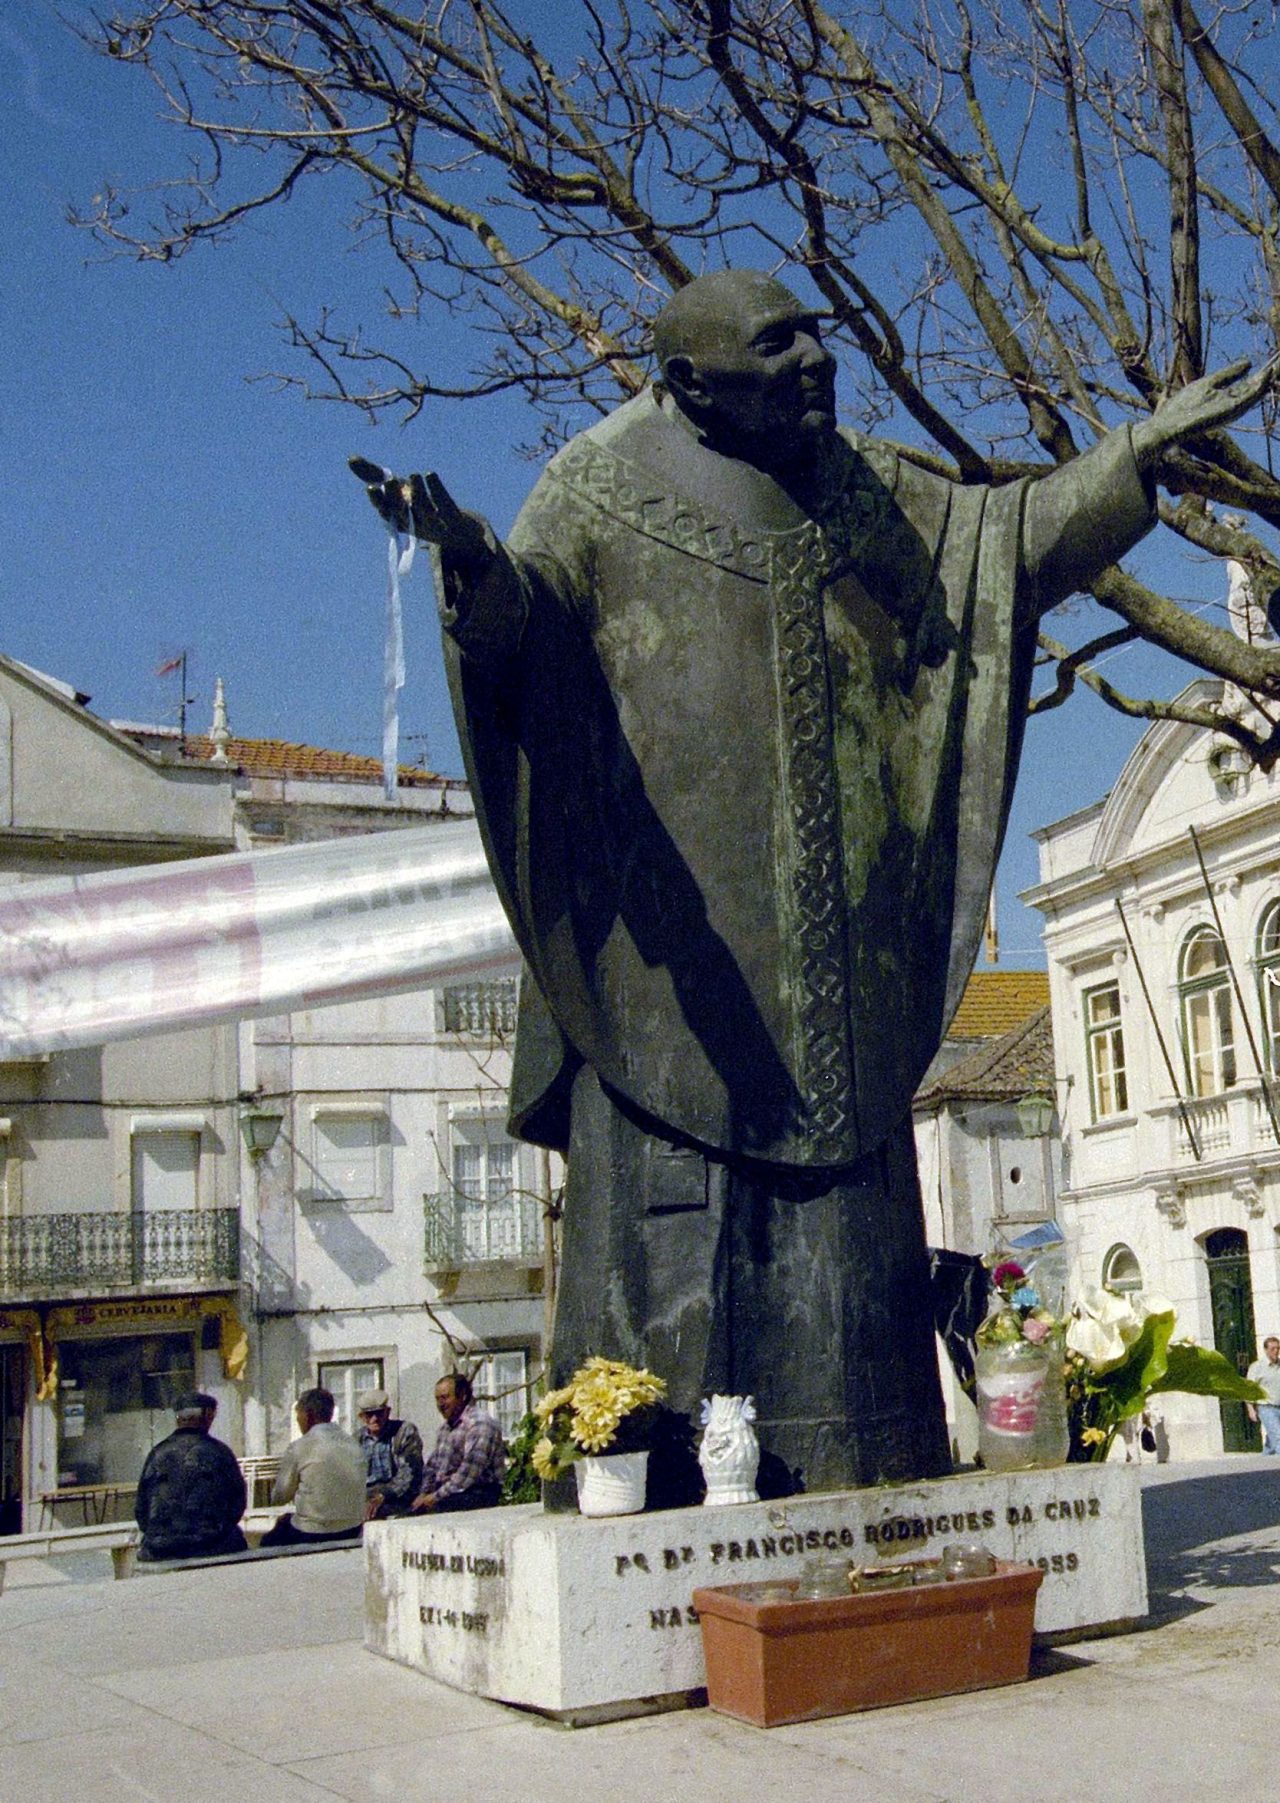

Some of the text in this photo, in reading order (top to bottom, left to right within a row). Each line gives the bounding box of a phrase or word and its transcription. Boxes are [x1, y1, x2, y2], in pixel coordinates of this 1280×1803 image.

[100, 1304, 177, 1318] CERVEJARIA
[710, 1527, 855, 1566] FRANCISCO
[864, 1508, 997, 1544] RODRIGUES
[1005, 1505, 1034, 1529] DA
[1044, 1497, 1101, 1522] CRUZ
